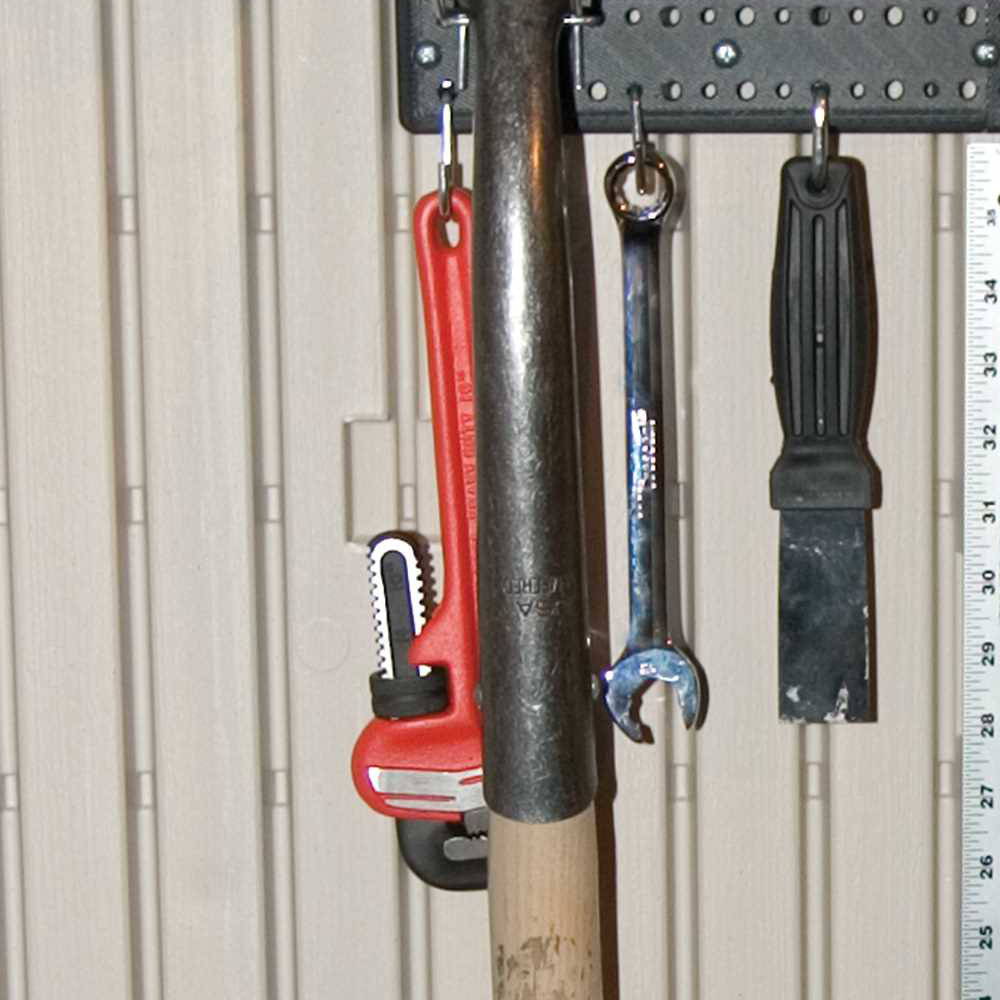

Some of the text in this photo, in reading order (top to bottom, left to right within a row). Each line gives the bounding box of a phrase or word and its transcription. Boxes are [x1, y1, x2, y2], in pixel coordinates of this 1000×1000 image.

[984, 279, 998, 304] 34
[983, 352, 998, 377] 33
[983, 425, 997, 450] 32
[982, 500, 996, 524] 31
[982, 570, 996, 595] 30
[981, 641, 995, 667] 29
[980, 713, 994, 738] 28
[980, 785, 994, 809] 27
[979, 855, 993, 879] 26
[979, 925, 993, 950] 25
